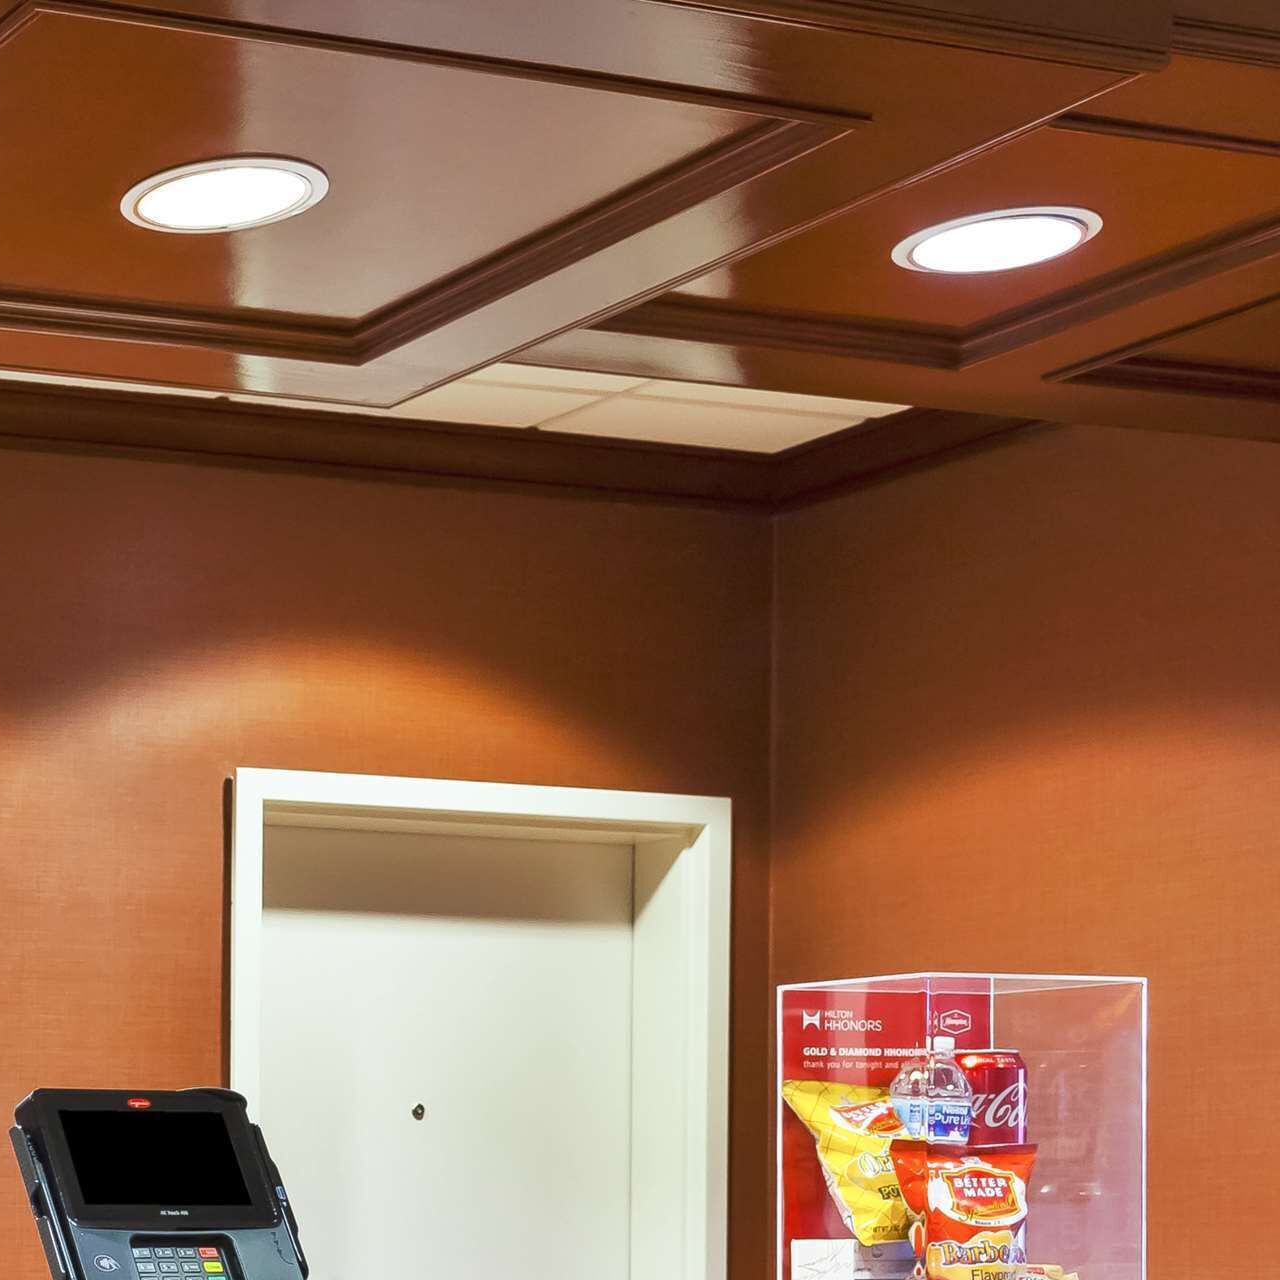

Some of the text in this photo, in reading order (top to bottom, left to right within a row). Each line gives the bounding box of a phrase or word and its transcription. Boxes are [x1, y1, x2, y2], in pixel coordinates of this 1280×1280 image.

[824, 1010, 853, 1019] HILTON
[824, 1020, 882, 1032] HHONORS
[803, 1047, 928, 1056] GOLD & DIAMOND HHONO
[803, 1060, 824, 1069] thank
[827, 1061, 841, 1070] you
[843, 1060, 854, 1069] for
[885, 1060, 899, 1069] and
[952, 1175, 1008, 1188] BETTER
[963, 1187, 1004, 1198] MADE
